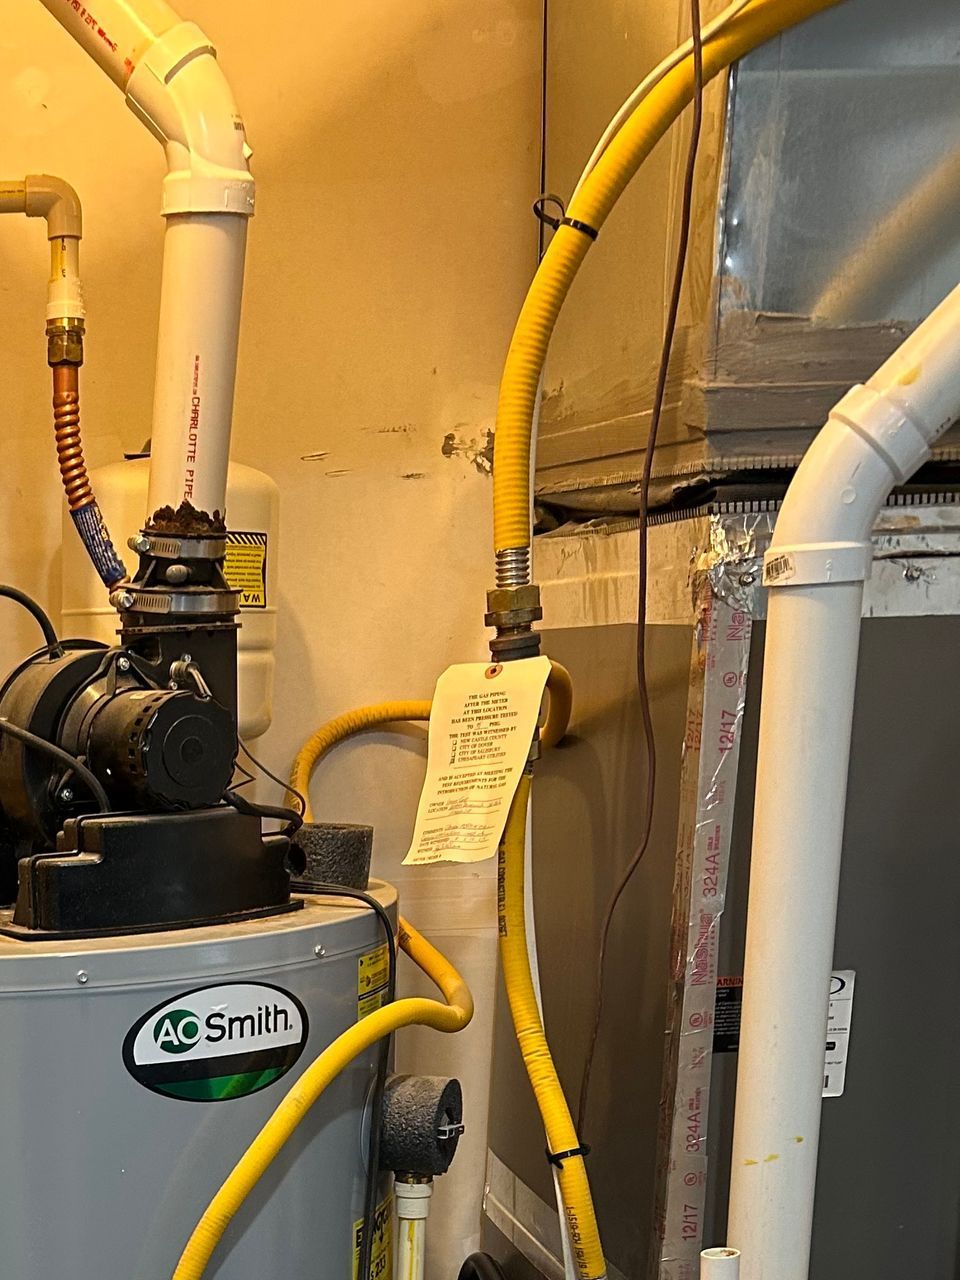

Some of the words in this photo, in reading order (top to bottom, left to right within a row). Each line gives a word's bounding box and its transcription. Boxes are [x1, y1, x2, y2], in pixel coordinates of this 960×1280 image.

[187, 397, 200, 464] CHARLOTTE
[183, 470, 194, 499] PIPE
[717, 709, 737, 754] 12/17
[703, 852, 721, 898] 324A
[205, 1003, 290, 1043] Smith
[685, 1111, 702, 1152] 324A
[682, 1204, 698, 1241] 12/17
